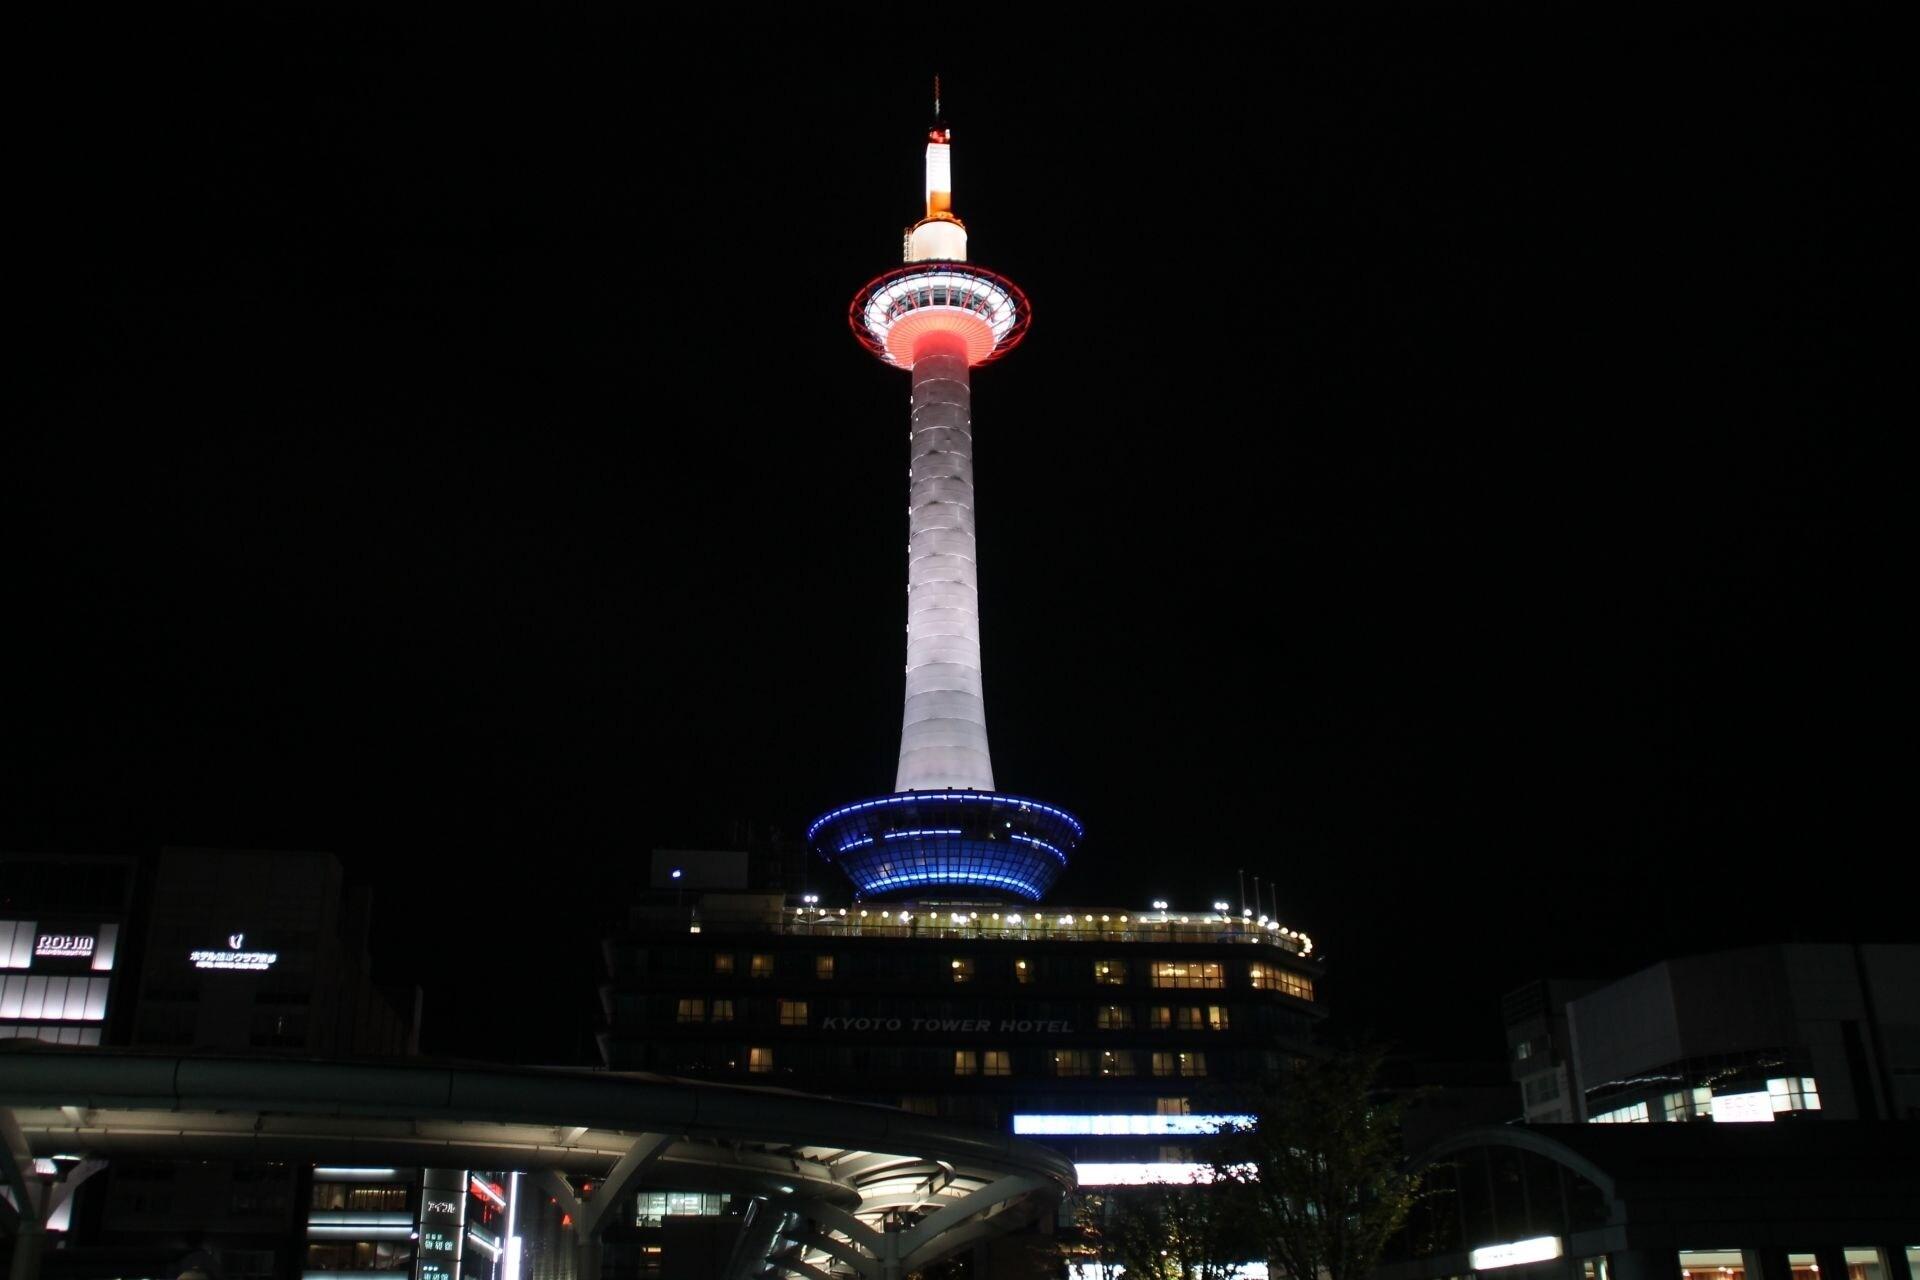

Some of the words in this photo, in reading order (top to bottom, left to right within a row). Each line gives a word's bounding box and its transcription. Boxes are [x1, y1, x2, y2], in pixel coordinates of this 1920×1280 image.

[37, 935, 94, 950] ROHM
[822, 1017, 902, 1031] KYOTO
[912, 1018, 991, 1032] TOWER
[1000, 1019, 1074, 1033] HOTEL
